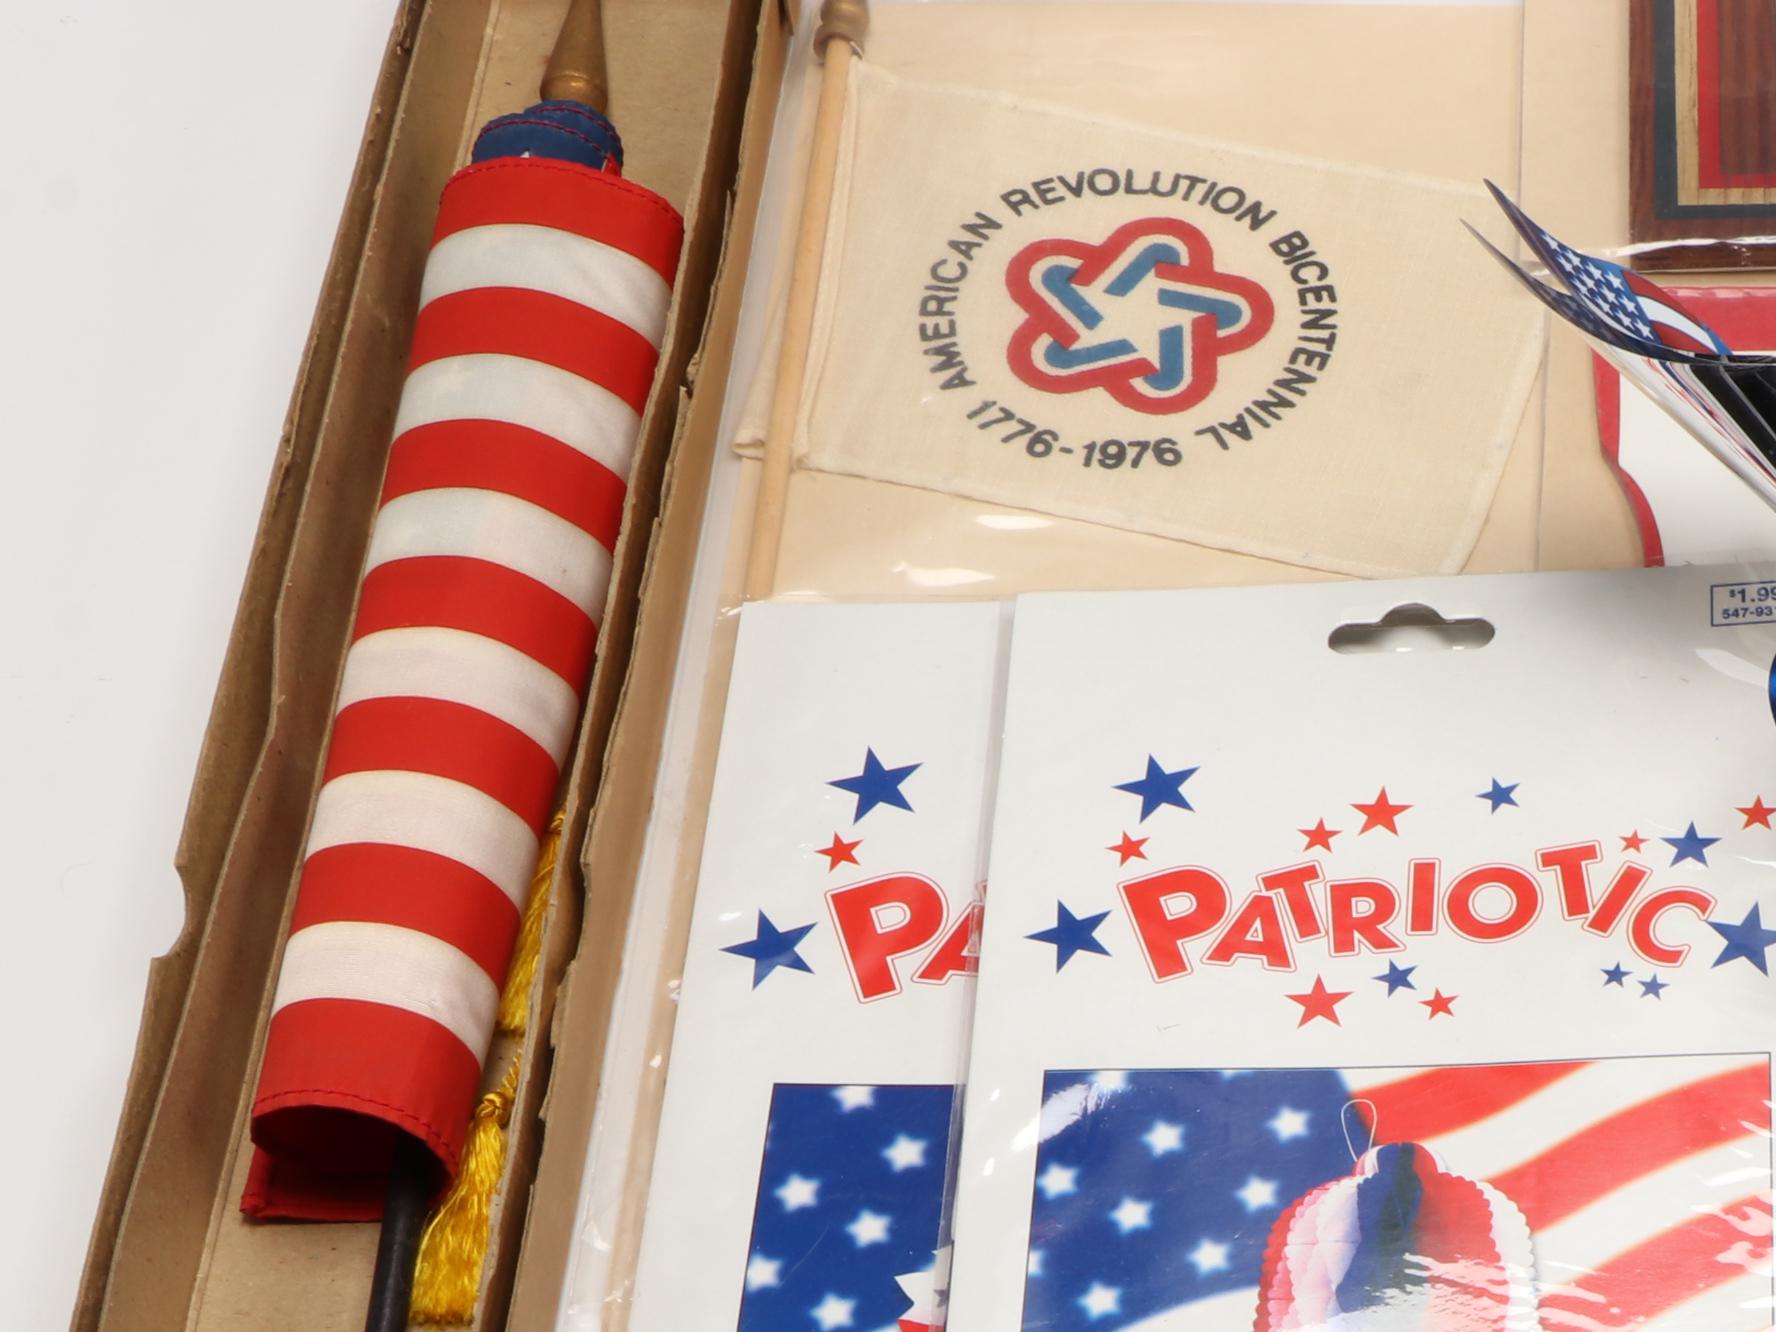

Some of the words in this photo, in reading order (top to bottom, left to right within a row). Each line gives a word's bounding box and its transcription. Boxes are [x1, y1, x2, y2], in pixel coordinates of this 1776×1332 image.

[919, 211, 1003, 392] AMERICAN
[1000, 168, 1277, 232] REVOLUTION
[1195, 231, 1338, 450] BICENTENNIAL
[966, 400, 1183, 469] 1776-1976
[824, 871, 987, 1004] PA
[1117, 841, 1718, 984] PATRIOTIC
